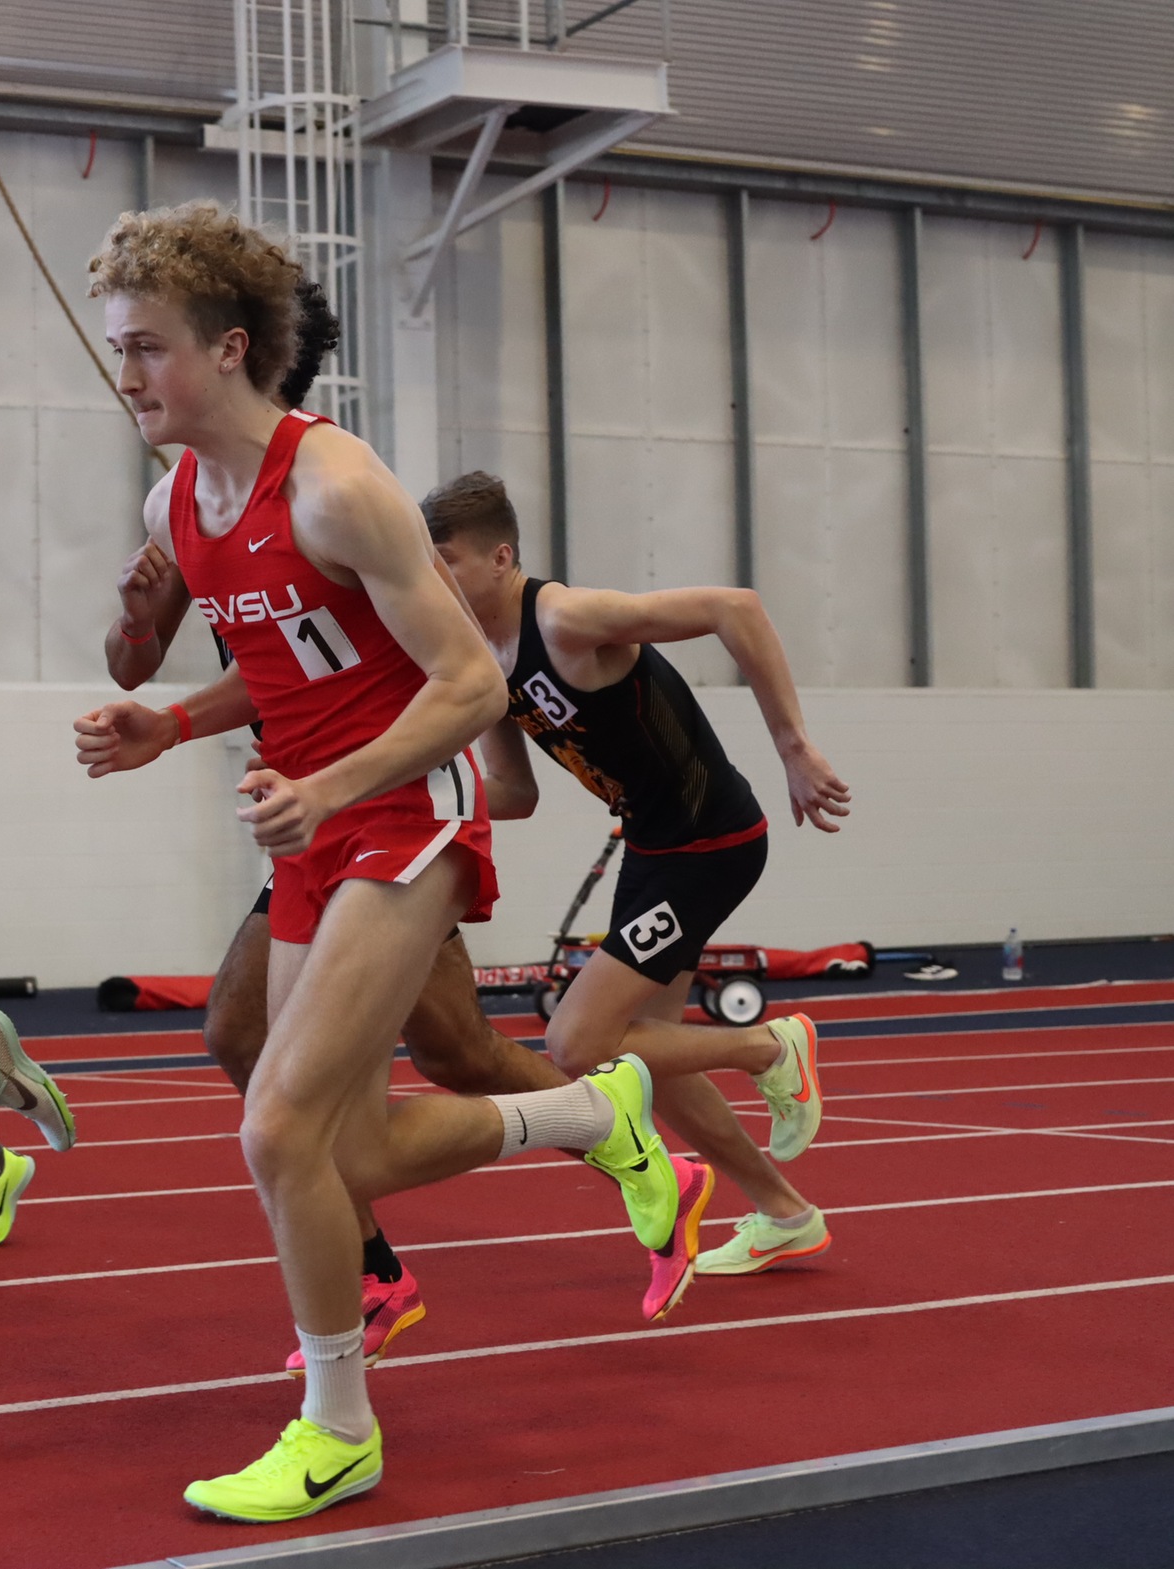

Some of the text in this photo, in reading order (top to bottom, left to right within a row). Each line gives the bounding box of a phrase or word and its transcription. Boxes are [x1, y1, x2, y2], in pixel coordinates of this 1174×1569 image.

[194, 584, 303, 624] SVSU
[296, 617, 343, 673] 1
[530, 680, 567, 721] 3
[438, 758, 465, 816] 1
[629, 911, 676, 952] 3
